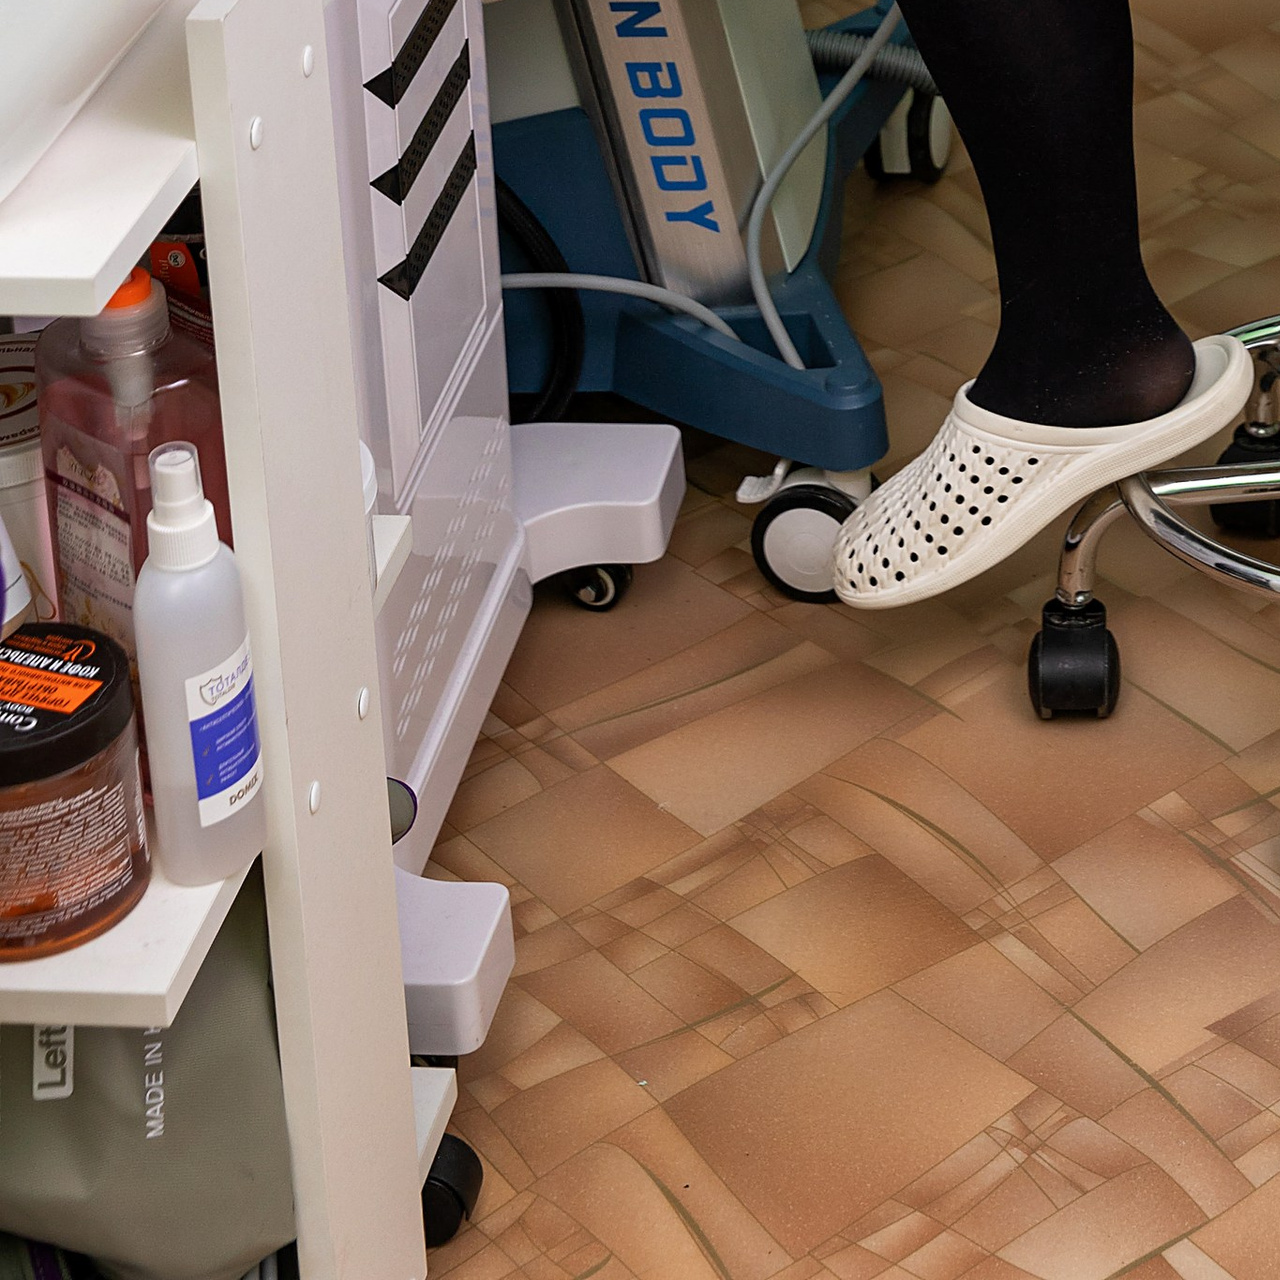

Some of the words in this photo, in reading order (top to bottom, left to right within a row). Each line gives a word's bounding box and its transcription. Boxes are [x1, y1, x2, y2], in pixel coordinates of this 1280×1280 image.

[624, 61, 720, 233] BODY
[47, 658, 64, 671] И
[59, 661, 101, 679] КОФЕ
[37, 1025, 68, 1091] Left
[144, 1040, 163, 1066] IN
[144, 1070, 165, 1139] MADE
